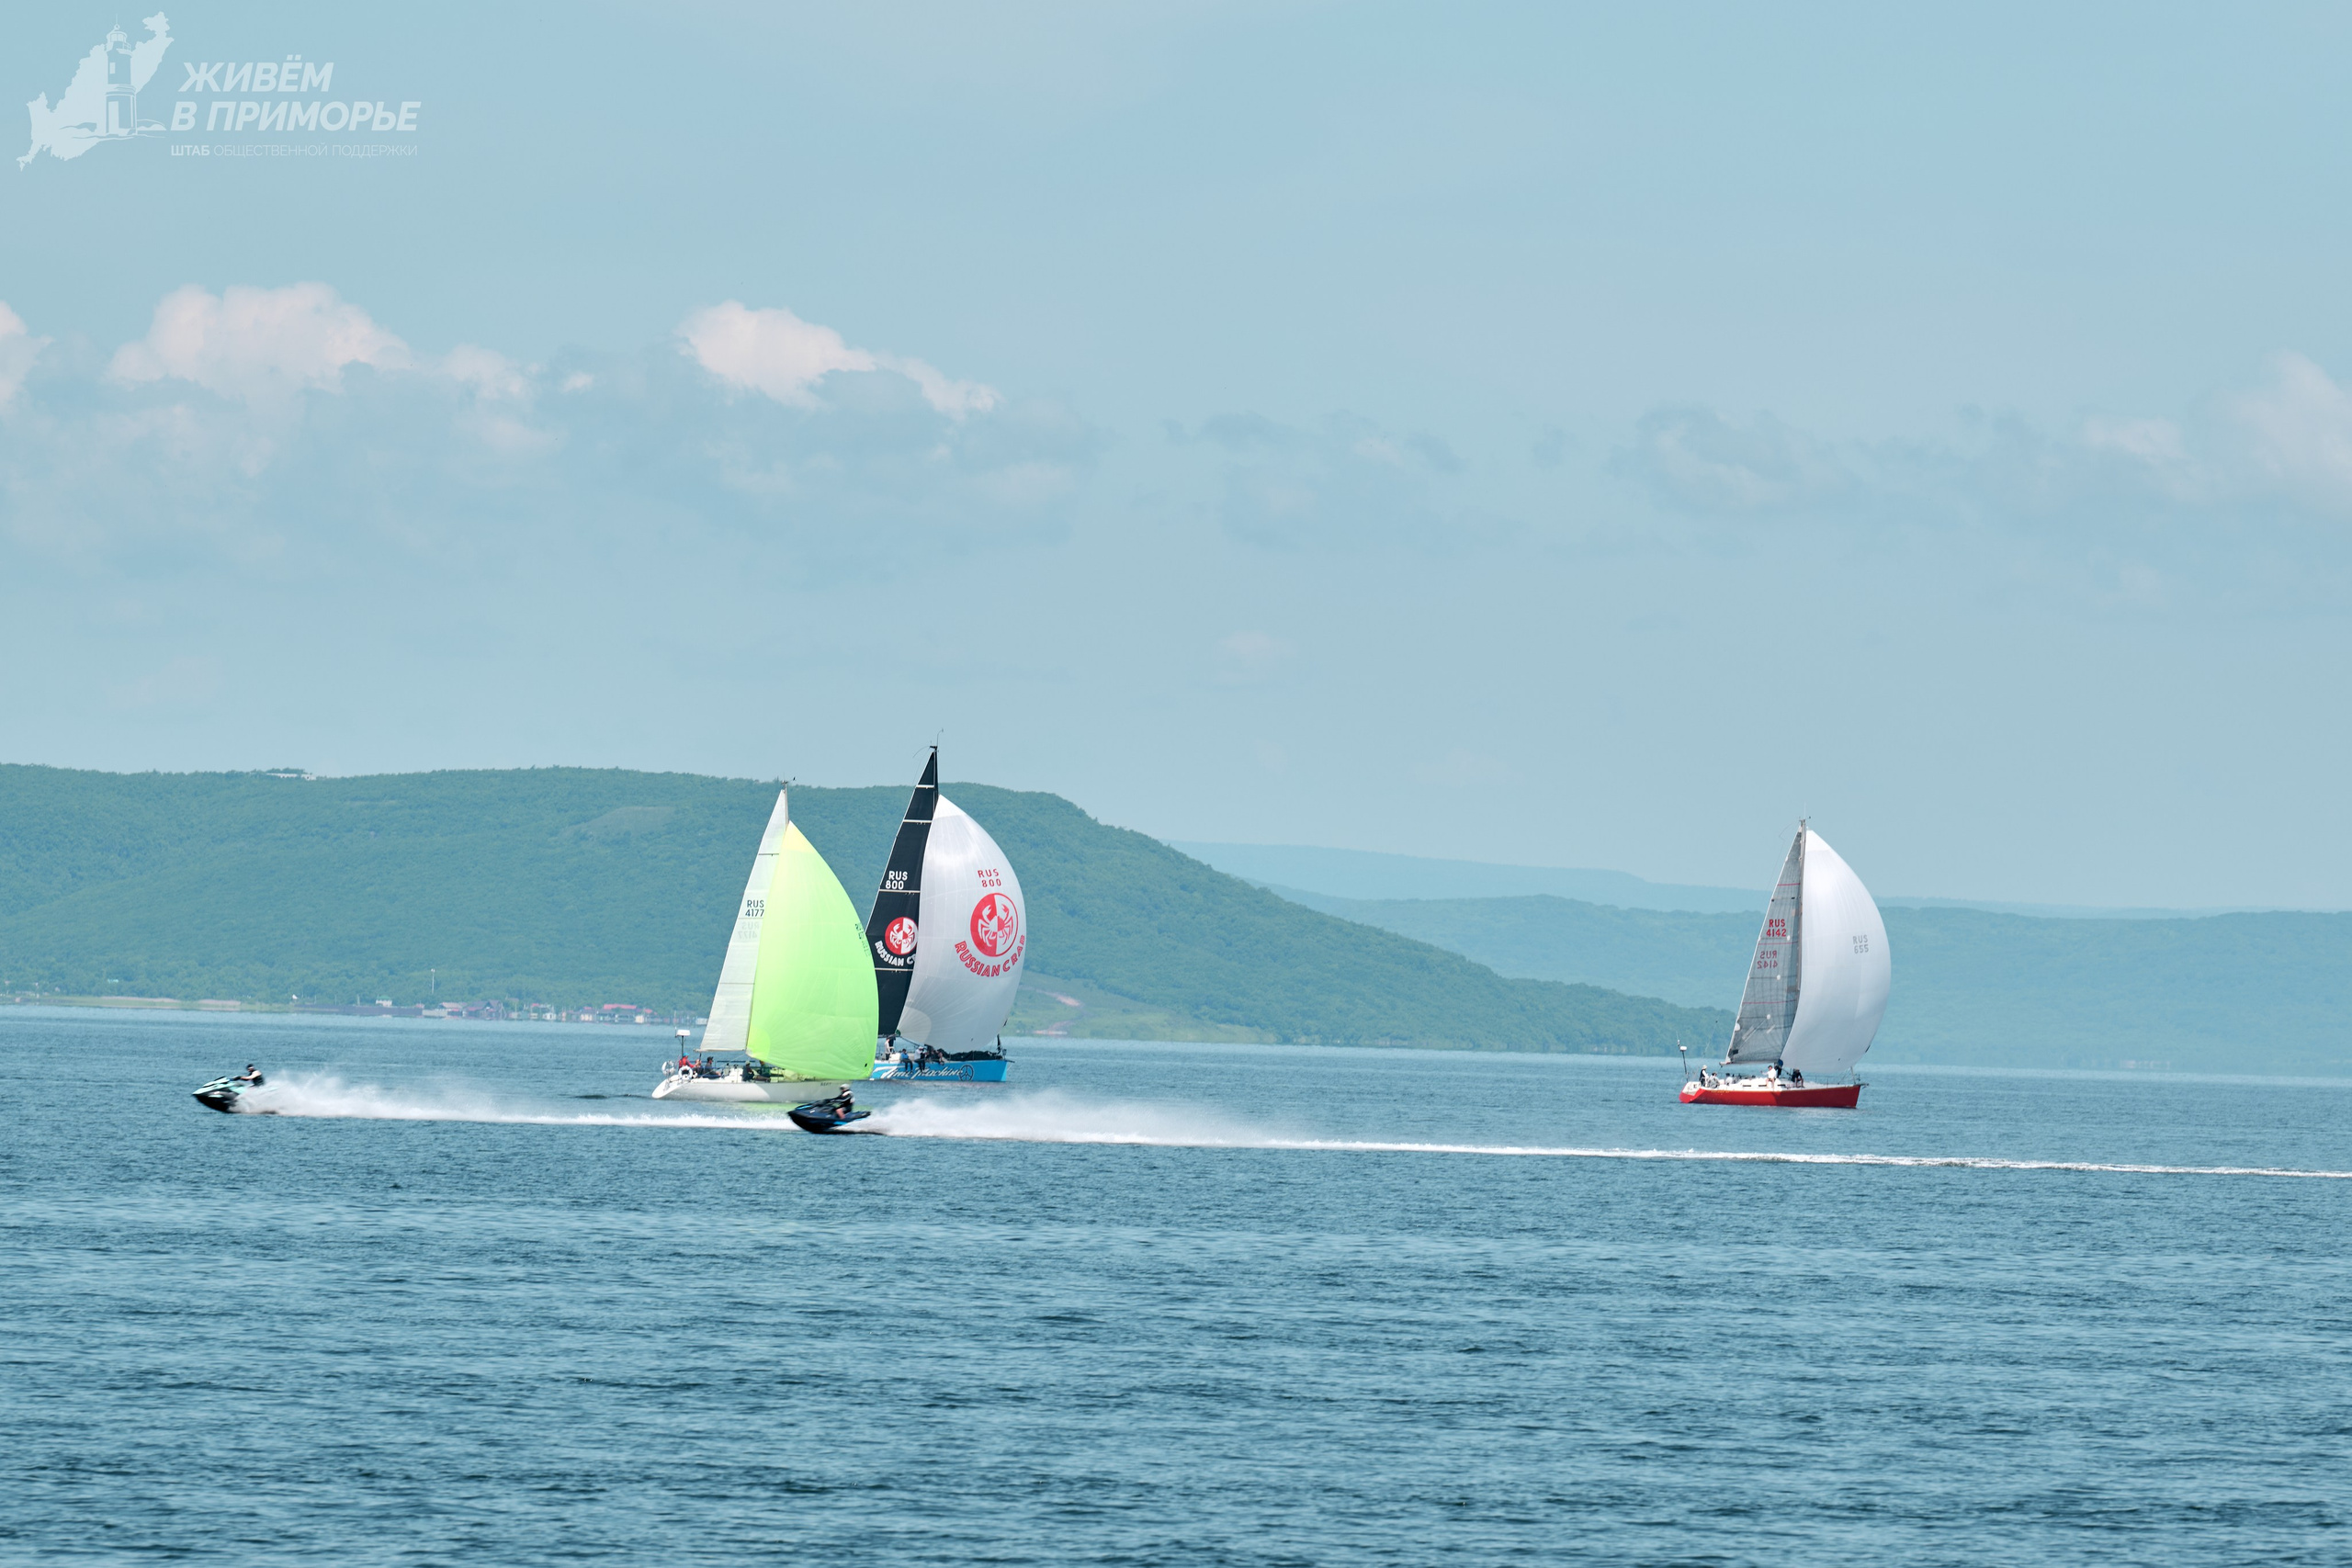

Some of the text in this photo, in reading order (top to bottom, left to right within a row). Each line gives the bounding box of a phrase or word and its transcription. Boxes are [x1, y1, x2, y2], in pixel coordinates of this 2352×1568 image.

[888, 870, 909, 881] RUS
[977, 868, 1000, 878] RUS
[885, 880, 904, 890] 800
[981, 878, 1002, 888] 800
[746, 899, 764, 908] RUS
[744, 908, 764, 918] 4177
[1769, 919, 1786, 928] RUS
[1766, 928, 1787, 937] 4142
[1852, 934, 1869, 945] RUS
[875, 940, 905, 966] RUSSIAN
[955, 941, 1001, 977] RUSSIAN
